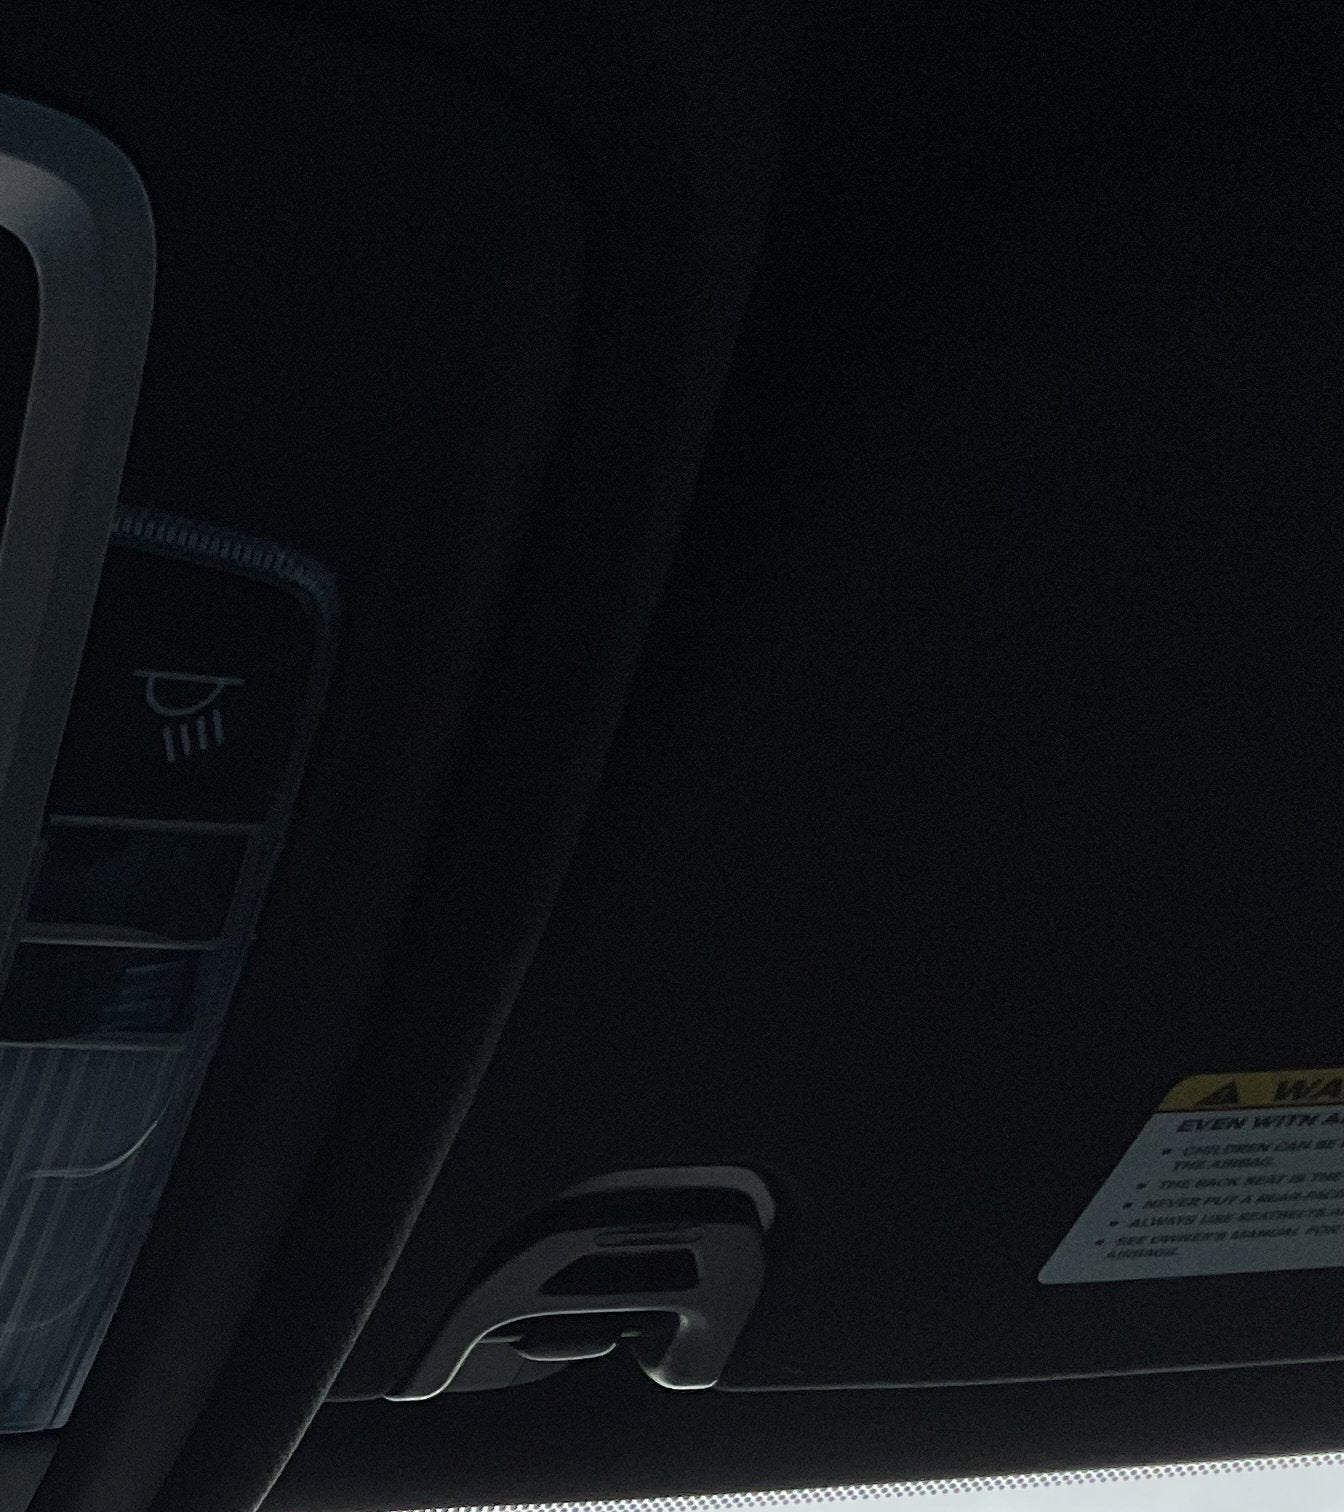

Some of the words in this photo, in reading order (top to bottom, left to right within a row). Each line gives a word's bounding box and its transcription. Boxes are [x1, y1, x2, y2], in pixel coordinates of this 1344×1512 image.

[1177, 1116, 1247, 1132] EVEN
[1252, 1114, 1320, 1129] WITH
[1184, 1143, 1272, 1156] CHILDREN
[1274, 1140, 1312, 1152] CAN
[1173, 1160, 1207, 1171] THE
